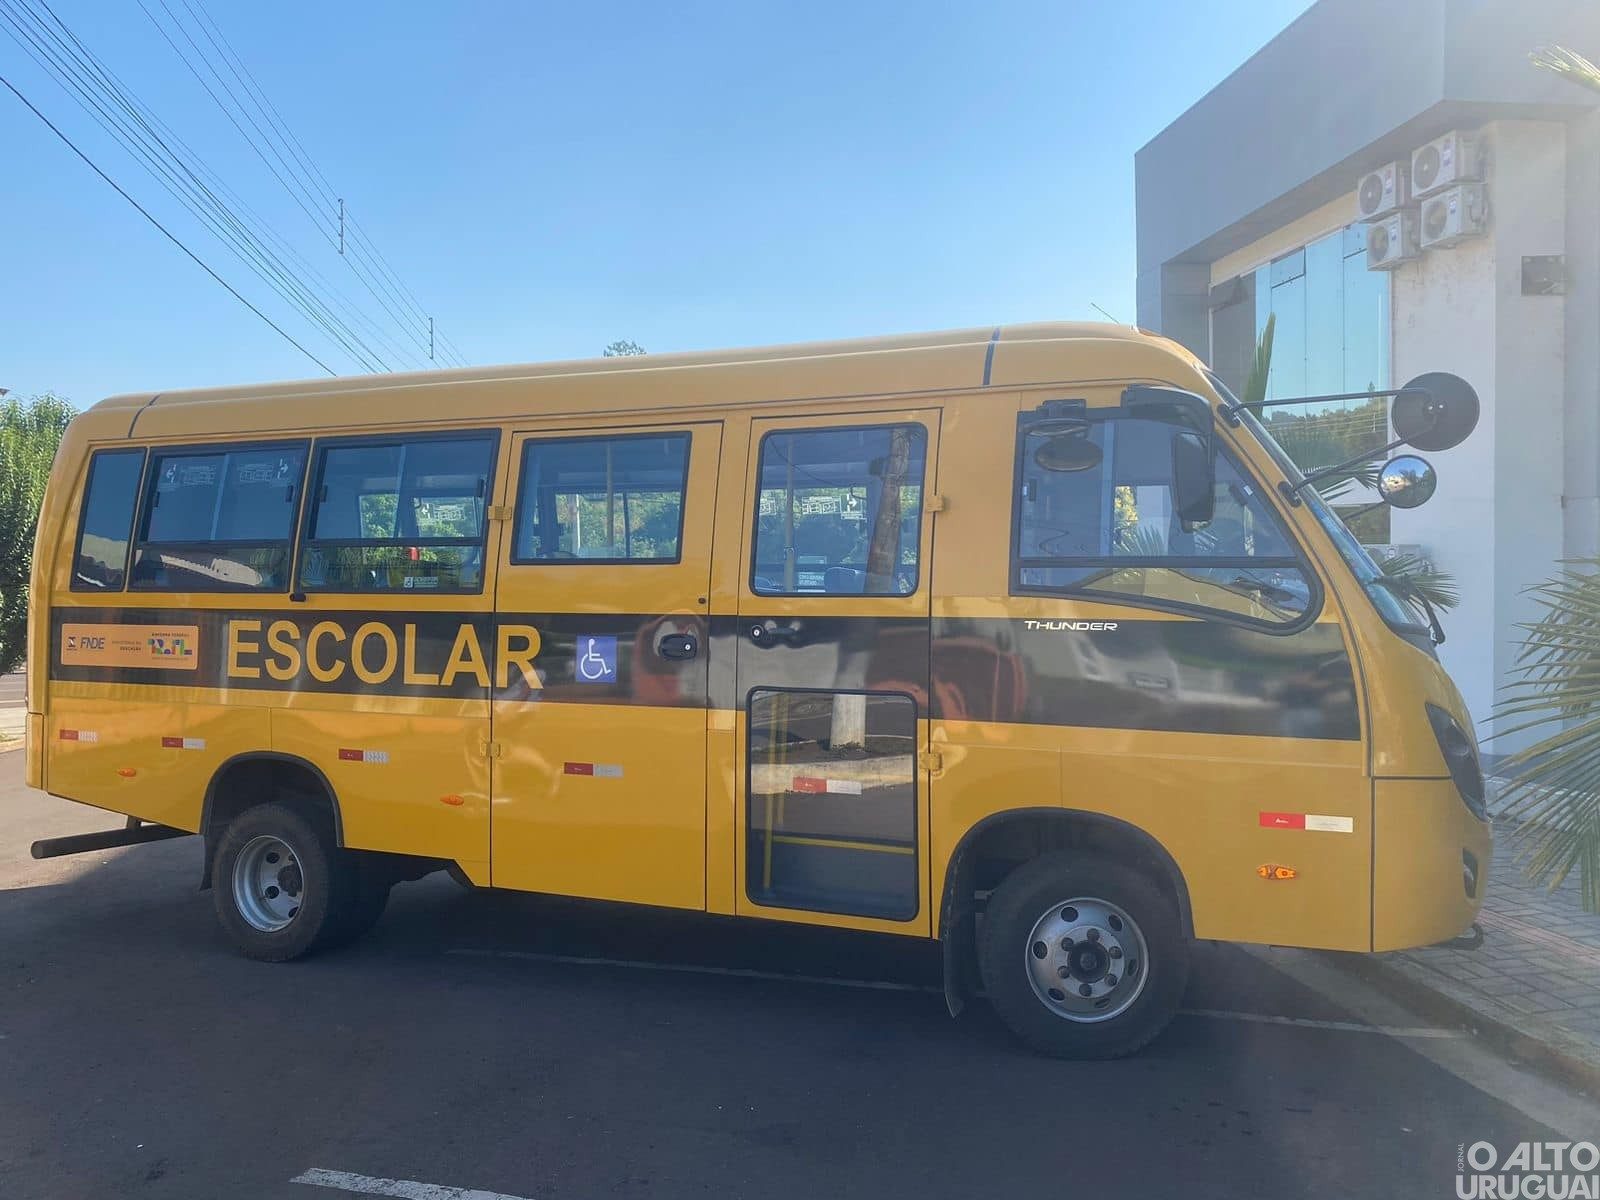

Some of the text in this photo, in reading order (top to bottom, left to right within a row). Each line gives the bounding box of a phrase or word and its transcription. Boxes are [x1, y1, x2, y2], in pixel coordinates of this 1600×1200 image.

[1023, 620, 1118, 631] THUNDER
[80, 636, 106, 650] FNDE
[226, 619, 545, 690] ESCOLAR
